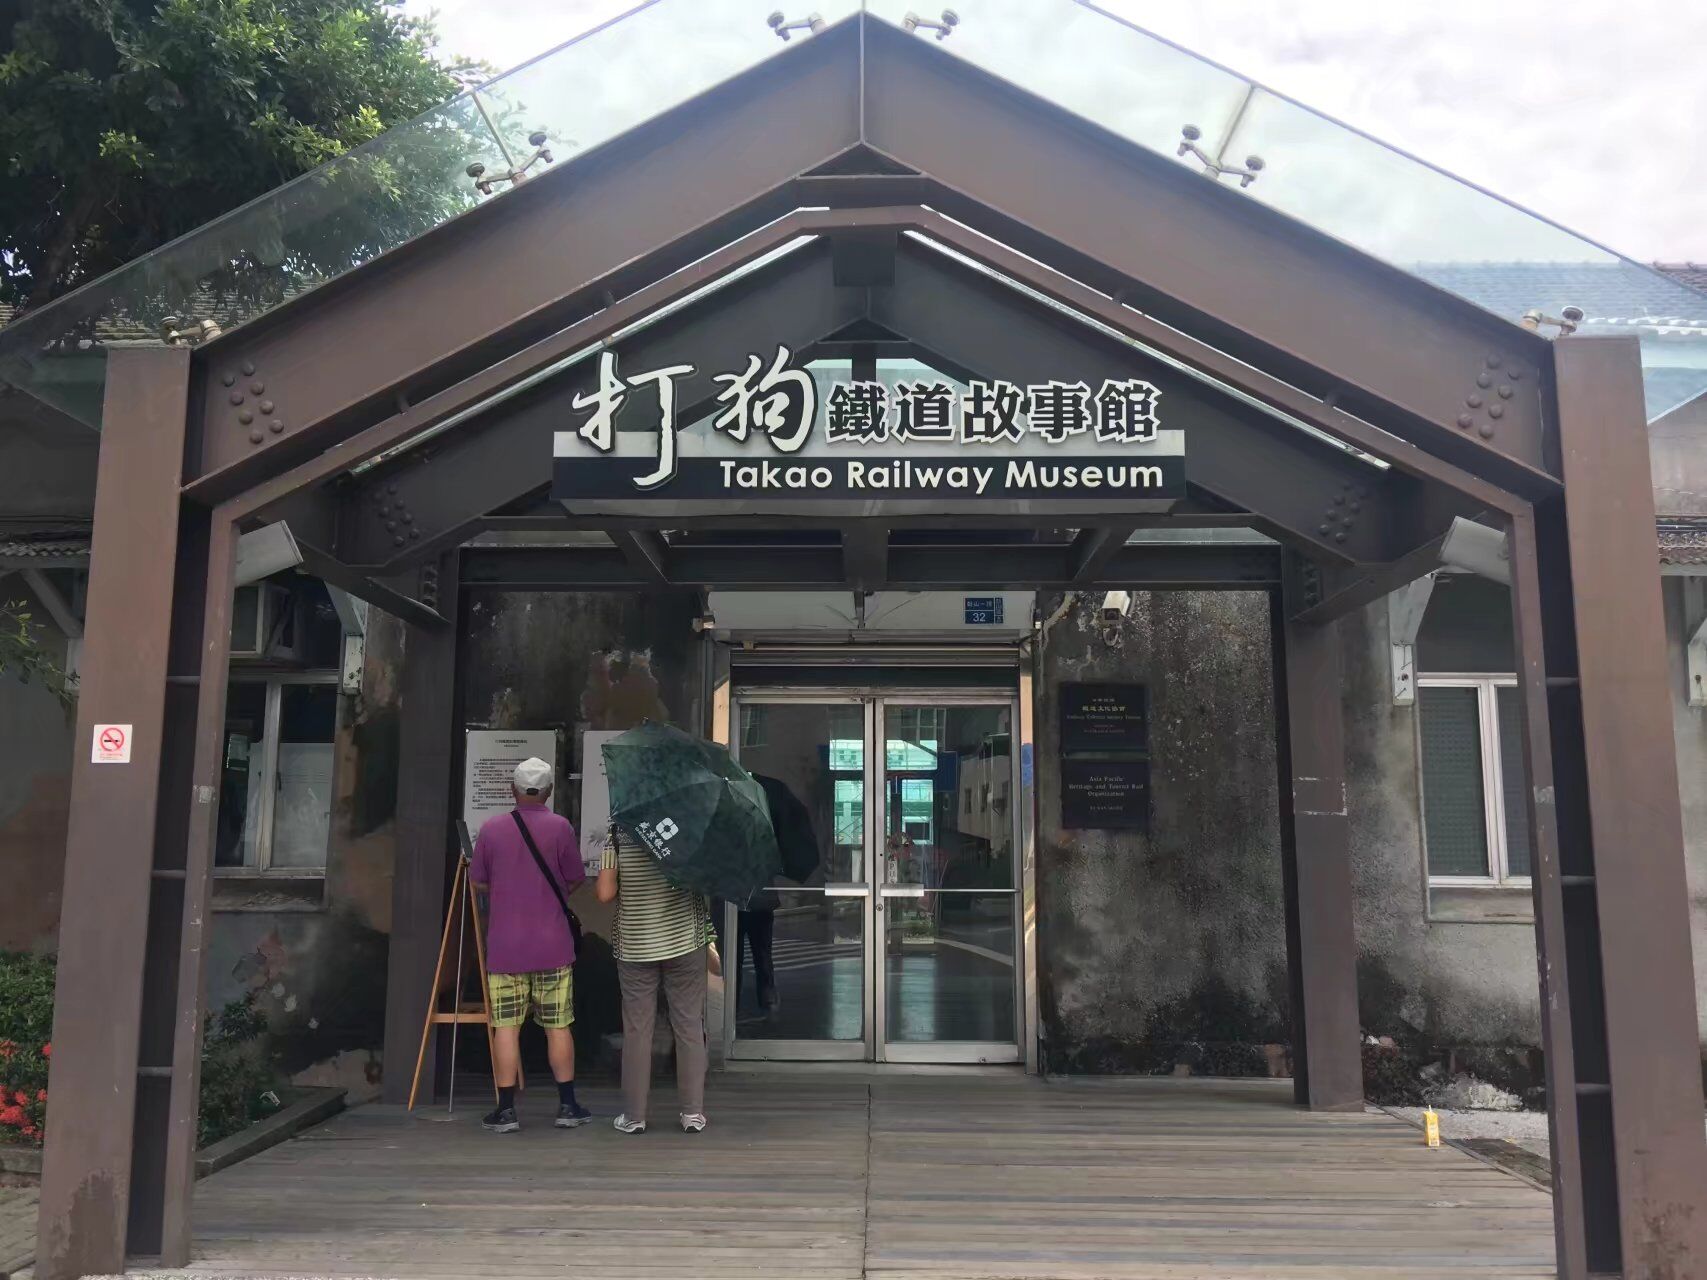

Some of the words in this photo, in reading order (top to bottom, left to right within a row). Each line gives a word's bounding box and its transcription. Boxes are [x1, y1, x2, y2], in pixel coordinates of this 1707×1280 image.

[571, 345, 1163, 490] 打狗鐵道故事館
[718, 459, 834, 489] Takao
[846, 459, 995, 495] Railway
[1003, 460, 1165, 488] Museum
[972, 612, 986, 622] 32
